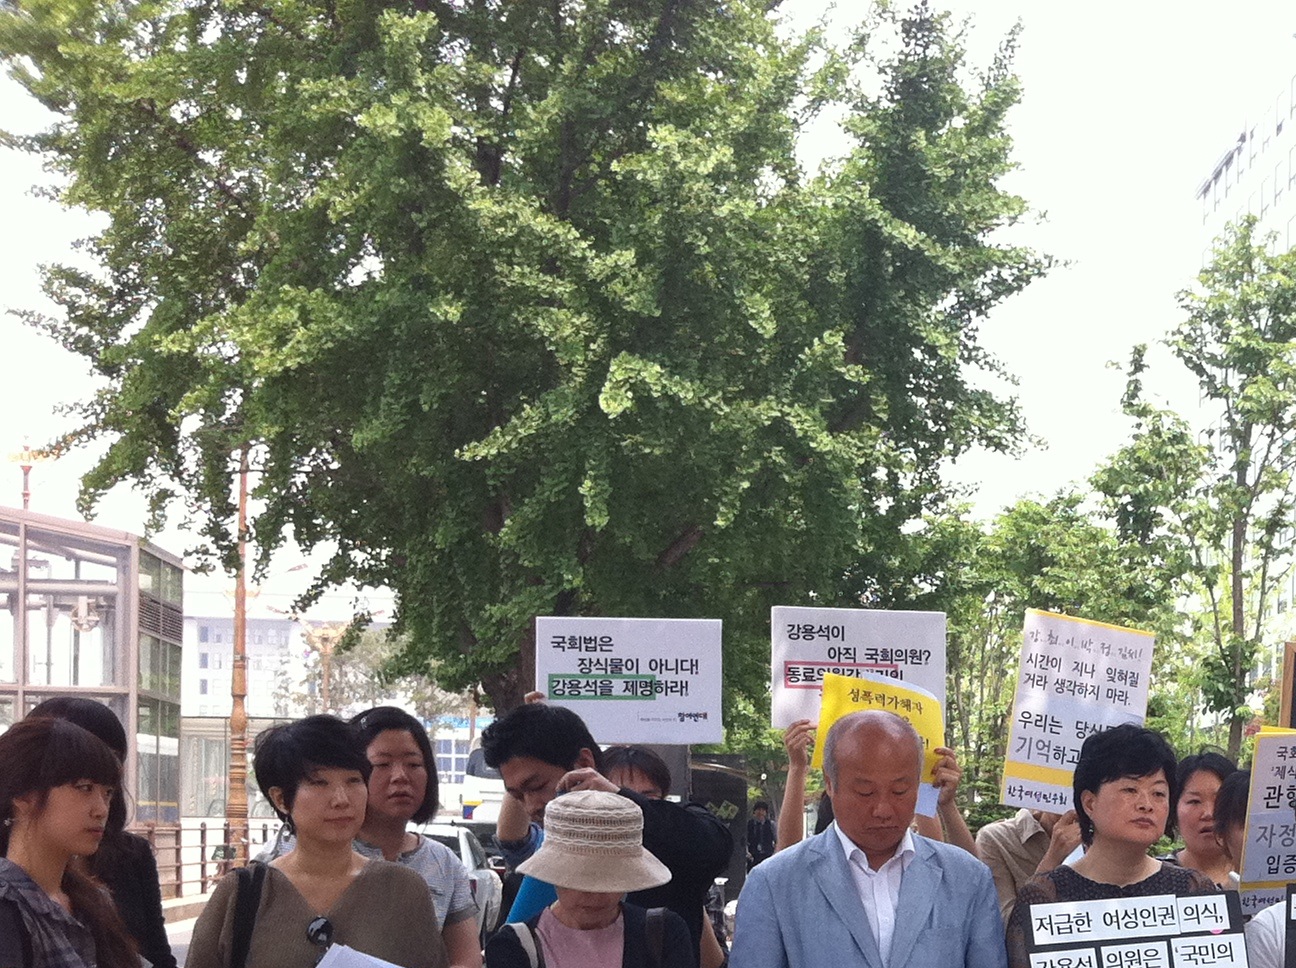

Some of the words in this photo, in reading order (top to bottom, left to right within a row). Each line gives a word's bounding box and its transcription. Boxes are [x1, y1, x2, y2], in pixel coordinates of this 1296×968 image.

[550, 635, 614, 652] 국회법은
[786, 623, 845, 641] 강용석이
[577, 657, 639, 675] 장식물이
[649, 658, 699, 675] 아니다!
[827, 647, 857, 663] 아직
[864, 649, 931, 665] 국회의원?
[1026, 653, 1062, 672] 시간이
[1072, 661, 1096, 679] 지나
[1106, 667, 1139, 688] 잊혀질
[551, 679, 614, 697] 강용석을
[623, 680, 689, 697] 제명하라!
[1023, 672, 1048, 690] 거라
[1053, 678, 1100, 700] 생각하지
[1106, 688, 1131, 706] 마라.
[848, 688, 923, 715] 성폭력가해자
[1018, 710, 1063, 735] 우리는
[1015, 736, 1081, 765] 기억하고
[1035, 911, 1092, 935] 저급한
[1103, 904, 1177, 930] 여성인권
[1184, 903, 1224, 924] 의식,
[1175, 942, 1235, 965] '국민의
